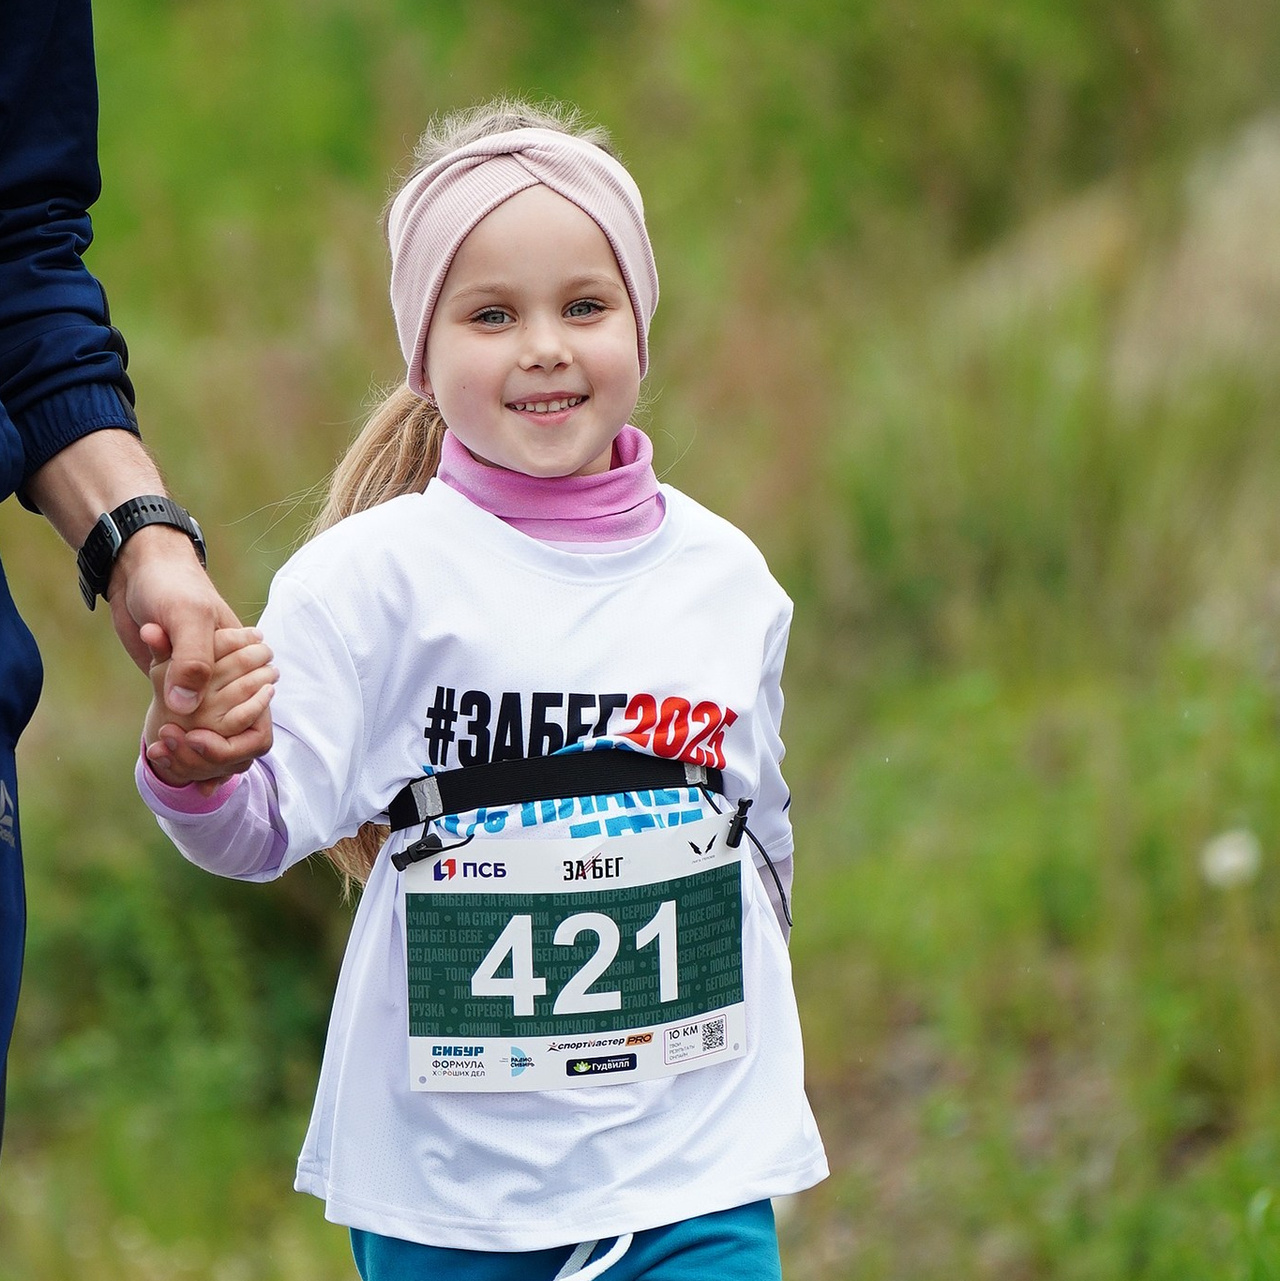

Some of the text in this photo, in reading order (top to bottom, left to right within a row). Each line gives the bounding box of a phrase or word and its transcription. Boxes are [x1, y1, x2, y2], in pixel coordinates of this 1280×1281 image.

[463, 862, 507, 878] ПСБ
[470, 899, 678, 1017] 421
[626, 1034, 653, 1045] PRO
[669, 1029, 680, 1040] 10
[432, 1046, 485, 1057] СИБУР
[432, 1060, 485, 1069] ФОРМУЛА
[592, 1061, 630, 1072] ГУДВИЛЛ
[470, 1070, 485, 1078] ДЕЛ
